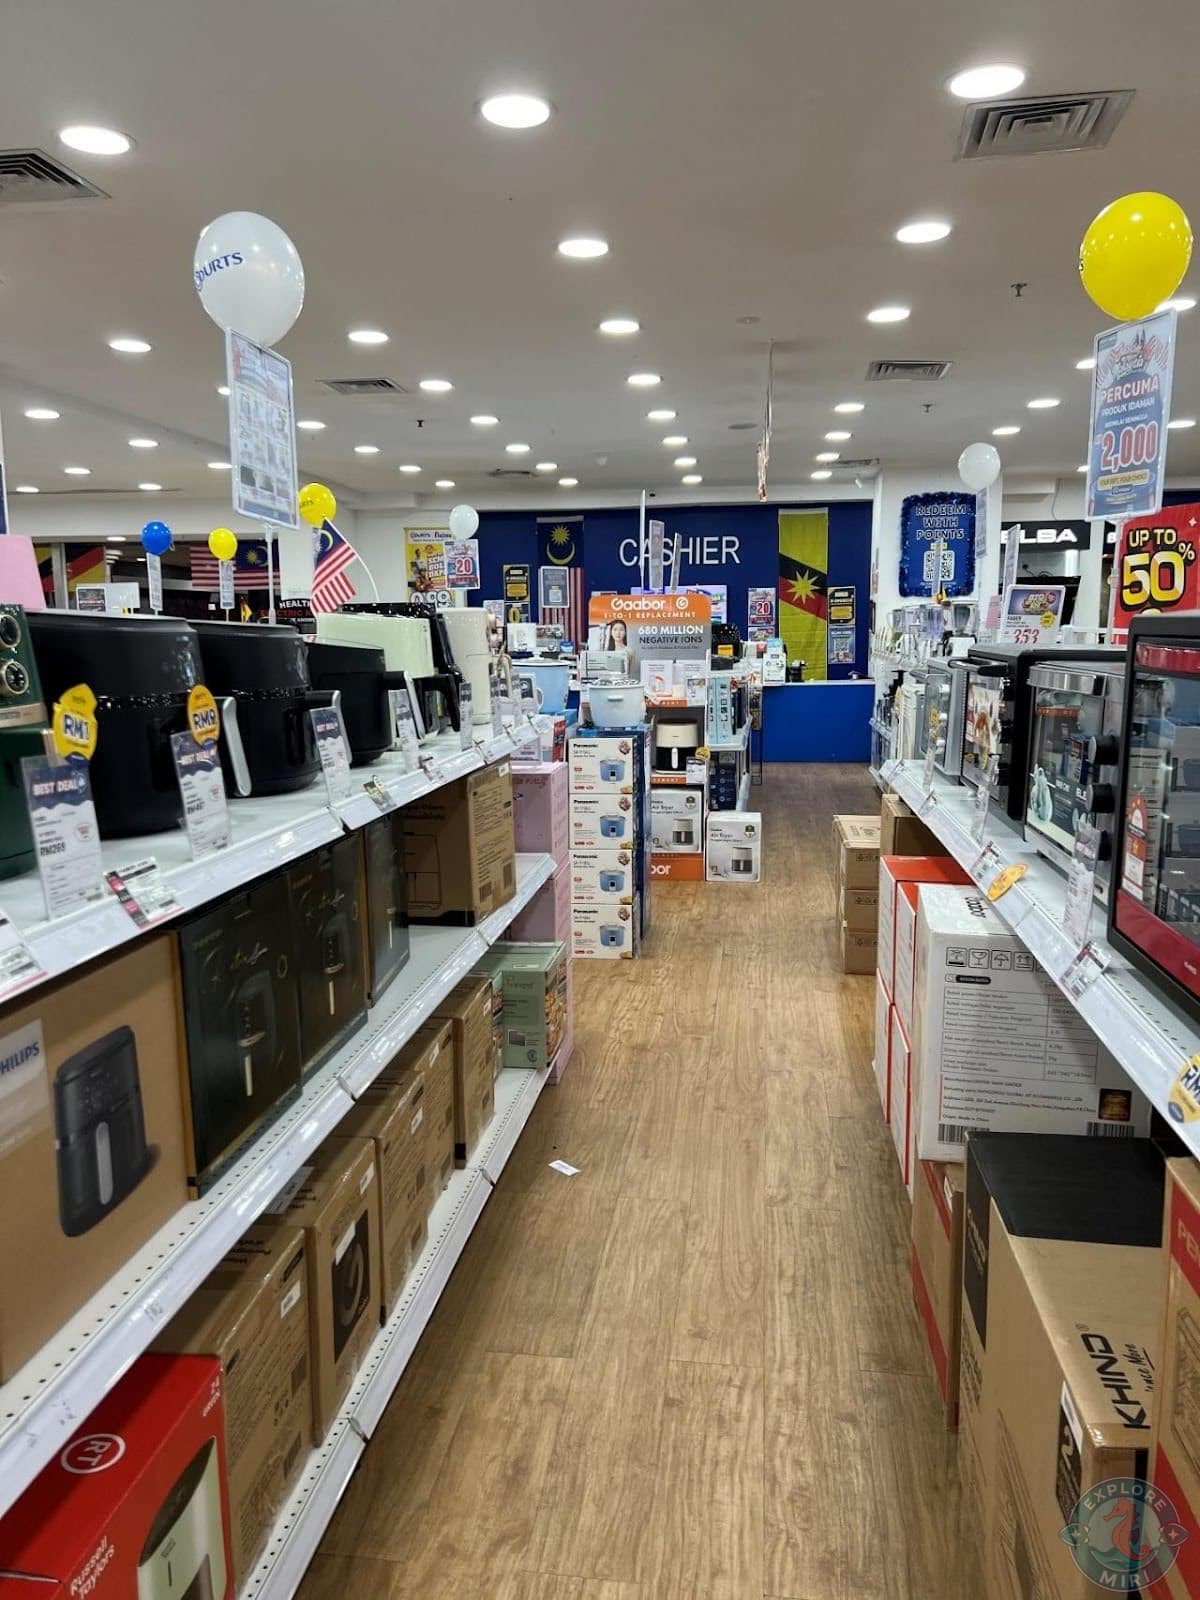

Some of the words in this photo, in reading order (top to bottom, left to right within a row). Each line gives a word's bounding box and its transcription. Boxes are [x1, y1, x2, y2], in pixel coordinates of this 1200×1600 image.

[1100, 374, 1159, 403] PERCUMA
[1100, 421, 1158, 473] 2,000
[915, 503, 967, 516] REDEEM
[922, 517, 959, 528] WITH
[916, 528, 965, 540] POINTS
[1128, 530, 1150, 547] UP
[1154, 528, 1177, 546] TO
[456, 558, 472, 575] 20
[610, 597, 667, 611] Gaabor
[756, 601, 771, 615] 20
[660, 625, 704, 635] MILLION
[639, 635, 679, 644] NEGATIVE
[681, 634, 703, 643] IONS
[33, 782, 56, 796] BEST
[1081, 1333, 1151, 1429] KHIND
[77, 1440, 113, 1467] RT
[70, 1535, 108, 1597] Russell
[78, 1544, 115, 1600] Taylors
